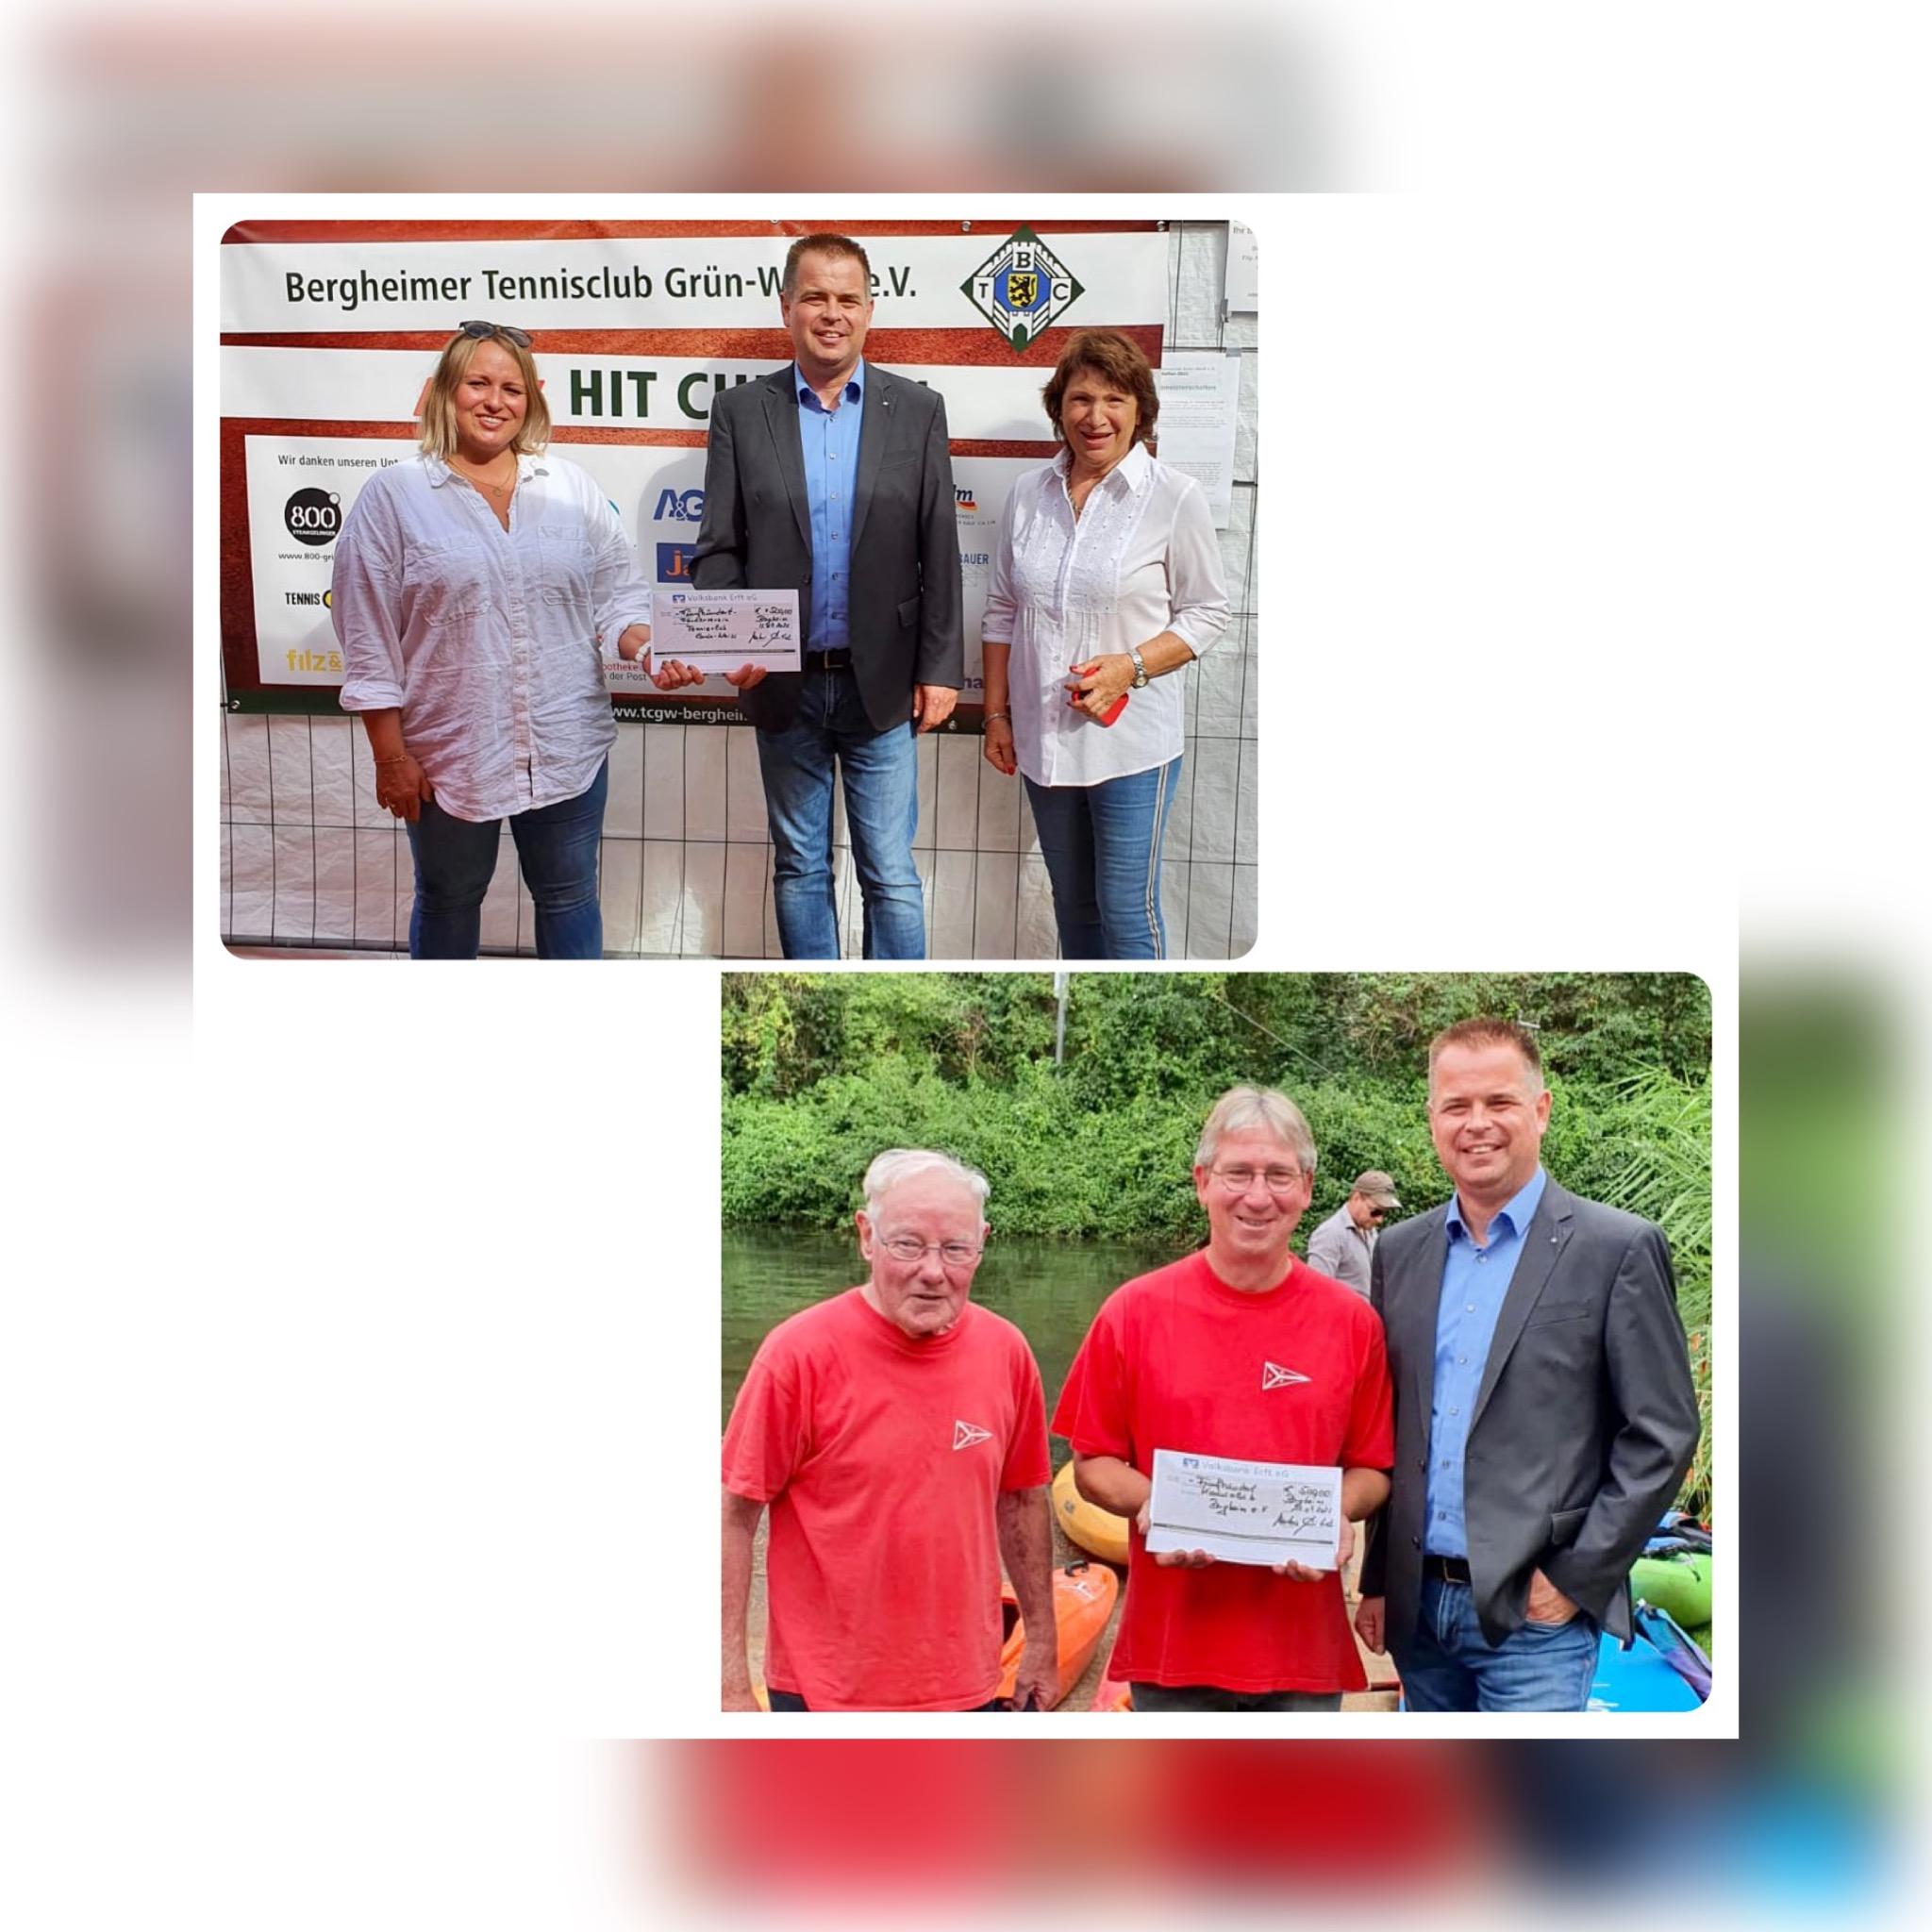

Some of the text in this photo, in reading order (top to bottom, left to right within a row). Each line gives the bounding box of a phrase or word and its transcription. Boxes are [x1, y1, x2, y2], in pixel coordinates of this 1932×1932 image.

[1015, 252, 1031, 268] B
[285, 269, 472, 310] Bergheimer
[482, 266, 653, 300] Tennisclub
[664, 265, 785, 297] Grün-W
[978, 283, 989, 298] T
[1053, 283, 1069, 301] C
[570, 369, 658, 418] HIT
[278, 455, 295, 465] Wir
[299, 455, 335, 466] danken
[338, 458, 377, 468] unseren
[291, 506, 336, 528] 800
[278, 553, 335, 562] www.800-gri
[285, 592, 321, 606] TENNIS
[602, 662, 639, 674] potheke
[609, 673, 624, 681] der
[626, 673, 647, 681] Post
[613, 707, 747, 724] ww.tcgw-berghei
